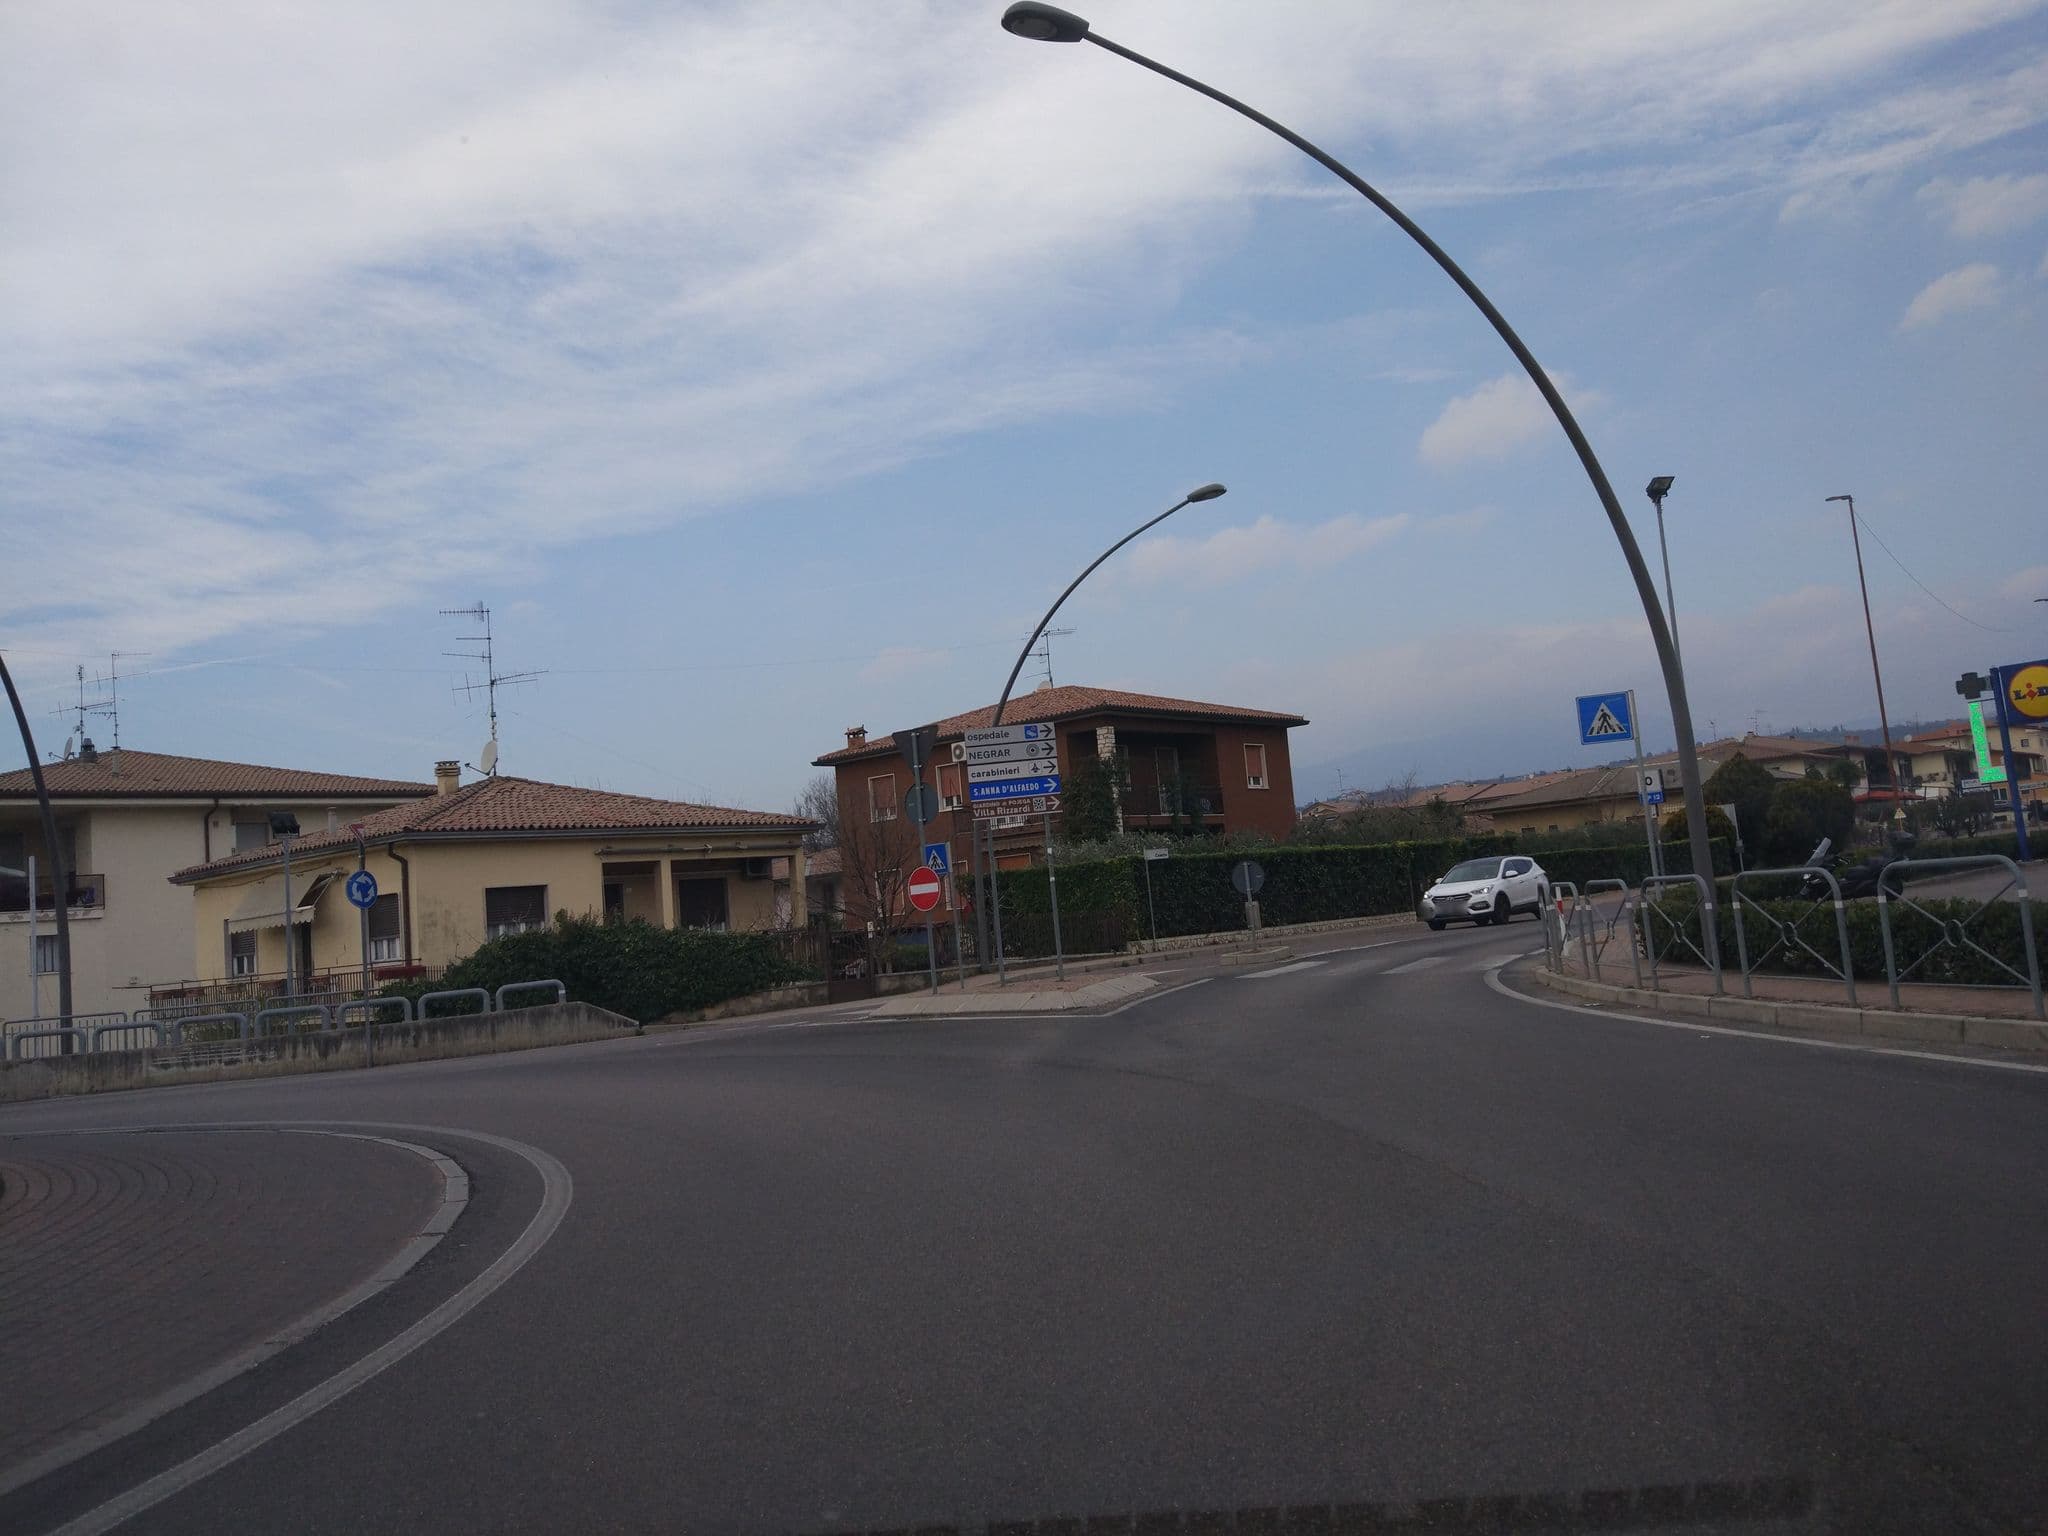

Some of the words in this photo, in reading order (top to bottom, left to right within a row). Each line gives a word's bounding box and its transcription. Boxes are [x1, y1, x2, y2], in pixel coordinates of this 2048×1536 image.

[967, 731, 1010, 741] ospedale
[968, 748, 1010, 760] NEGRAR
[971, 766, 1020, 778] carabinieri
[1002, 783, 1039, 793] D'ALFAEDO
[973, 808, 995, 818] Villa
[997, 804, 1031, 815] Rizzardi
